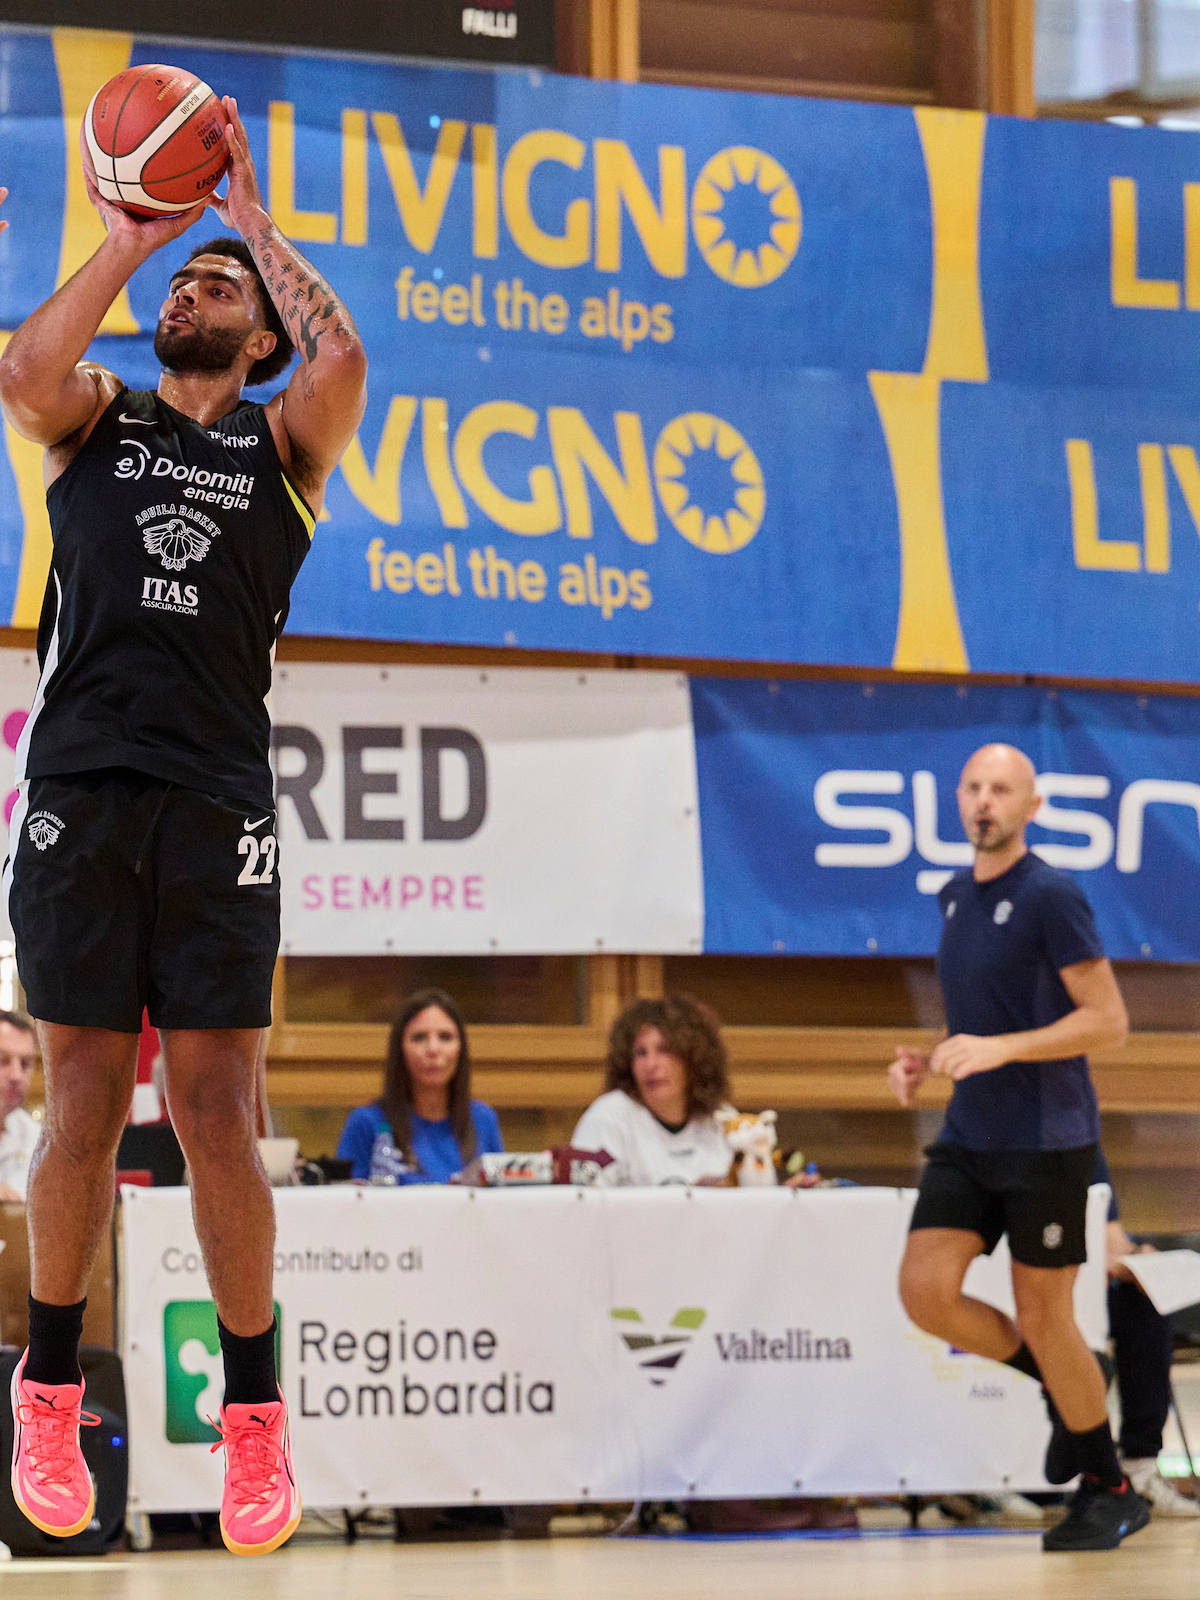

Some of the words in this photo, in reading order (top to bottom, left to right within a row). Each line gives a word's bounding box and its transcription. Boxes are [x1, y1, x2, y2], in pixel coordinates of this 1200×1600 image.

[462, 8, 517, 38] FALLI
[201, 122, 224, 151] FIBA
[267, 100, 802, 288] LIVIGNO
[395, 267, 486, 327] feel
[494, 277, 568, 335] the
[579, 288, 675, 352] alps
[151, 457, 255, 495] Dolomiti
[182, 486, 250, 511] energia
[134, 503, 177, 526] AQUILA
[178, 504, 222, 538] BASKET
[141, 576, 199, 607] ITAS
[366, 537, 461, 597] feel
[467, 546, 548, 603] the
[558, 553, 653, 620] alps
[140, 600, 199, 617] ASSICURAZIONI
[237, 835, 277, 886] 22
[301, 874, 485, 911] SEMPRE
[161, 1247, 200, 1274] Co
[273, 1245, 390, 1274] ontributo
[397, 1245, 423, 1274] di
[300, 1321, 497, 1373] Regione
[715, 1328, 853, 1363] Valtellina
[300, 1373, 555, 1418] Lombardia
